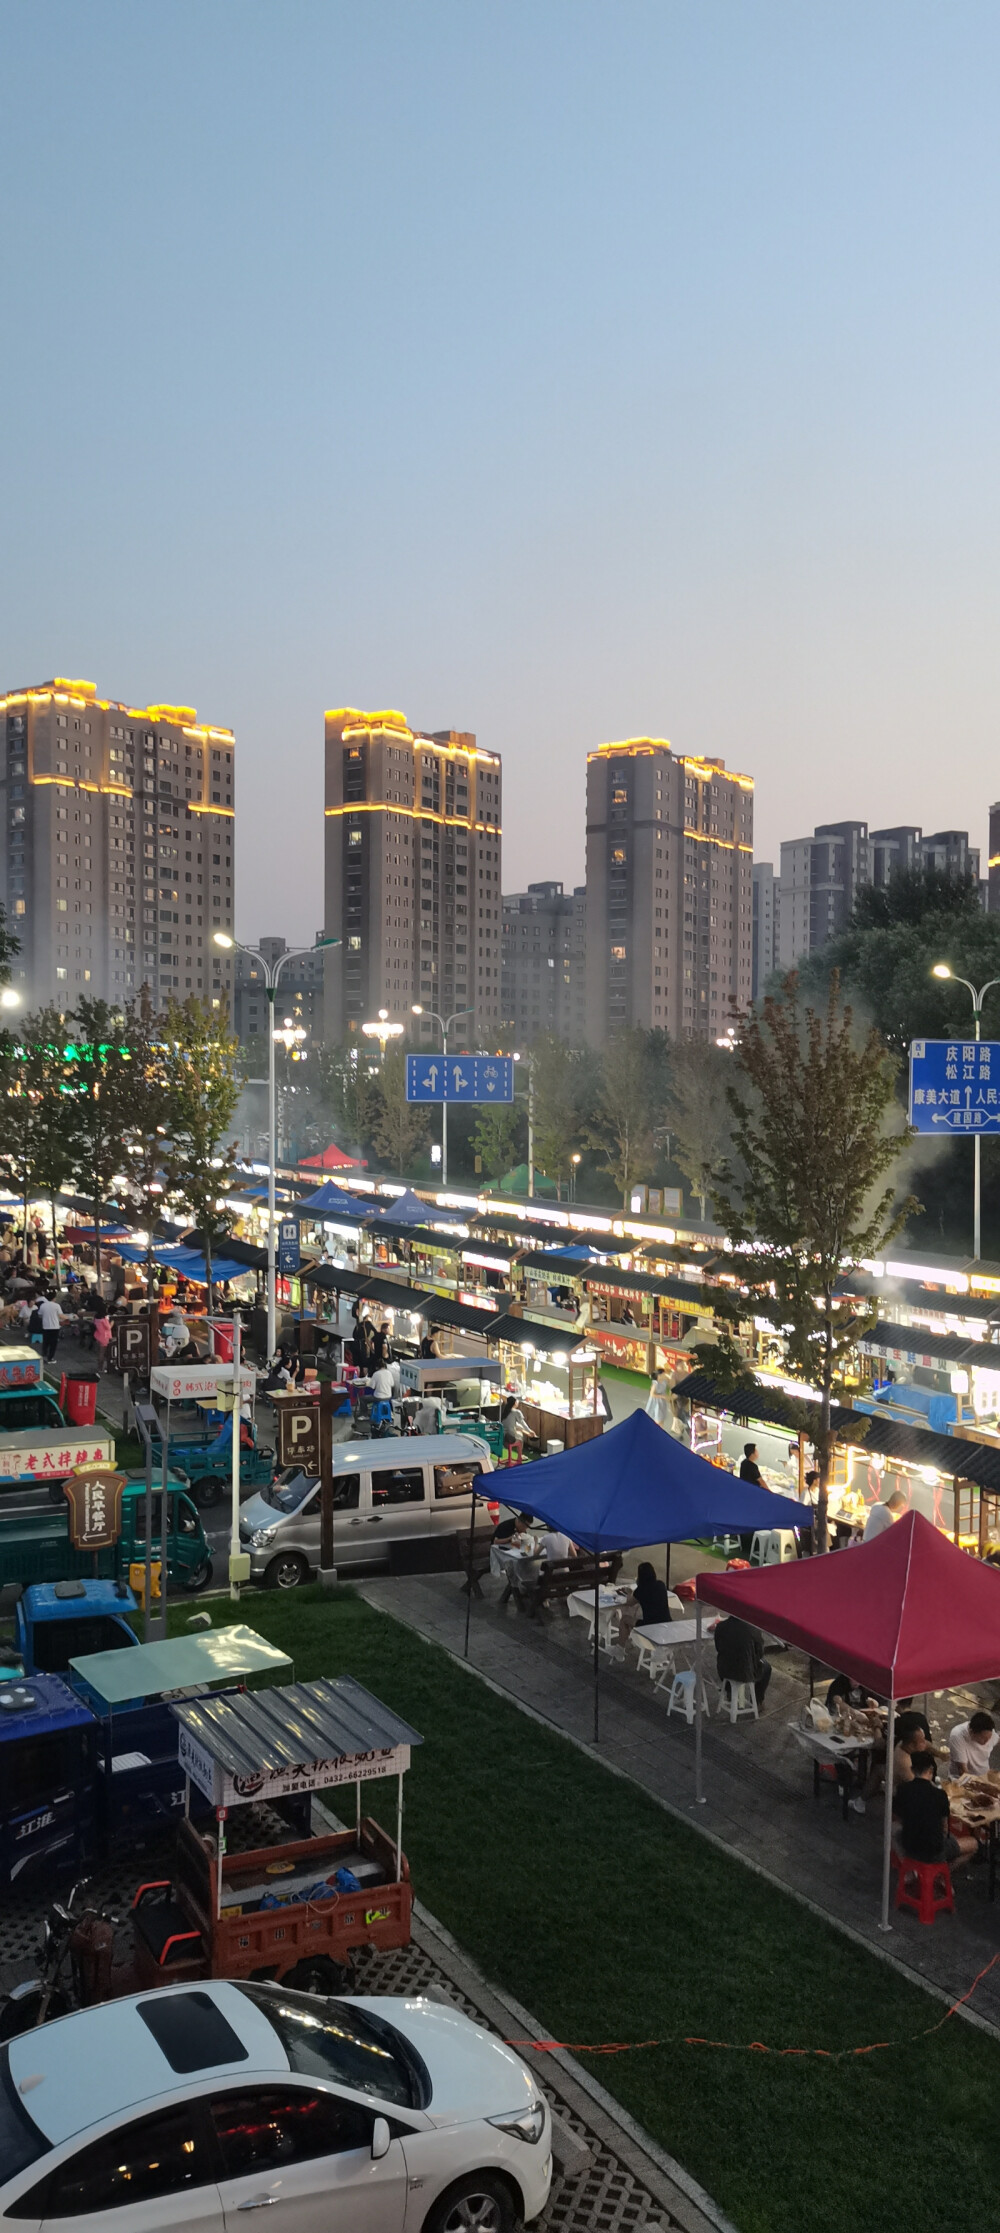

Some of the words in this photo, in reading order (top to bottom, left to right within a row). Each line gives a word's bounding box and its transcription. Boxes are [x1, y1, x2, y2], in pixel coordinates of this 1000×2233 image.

[946, 1045, 991, 1063] 庆阳路
[946, 1064, 991, 1080] 松江路
[914, 1088, 961, 1105] 康美大道
[976, 1088, 1000, 1105] 人民
[953, 1111, 982, 1124] 建国路
[126, 1330, 143, 1351] P
[291, 1415, 312, 1443] P
[170, 1789, 187, 1807] 江
[15, 1811, 57, 1840] 江淮
